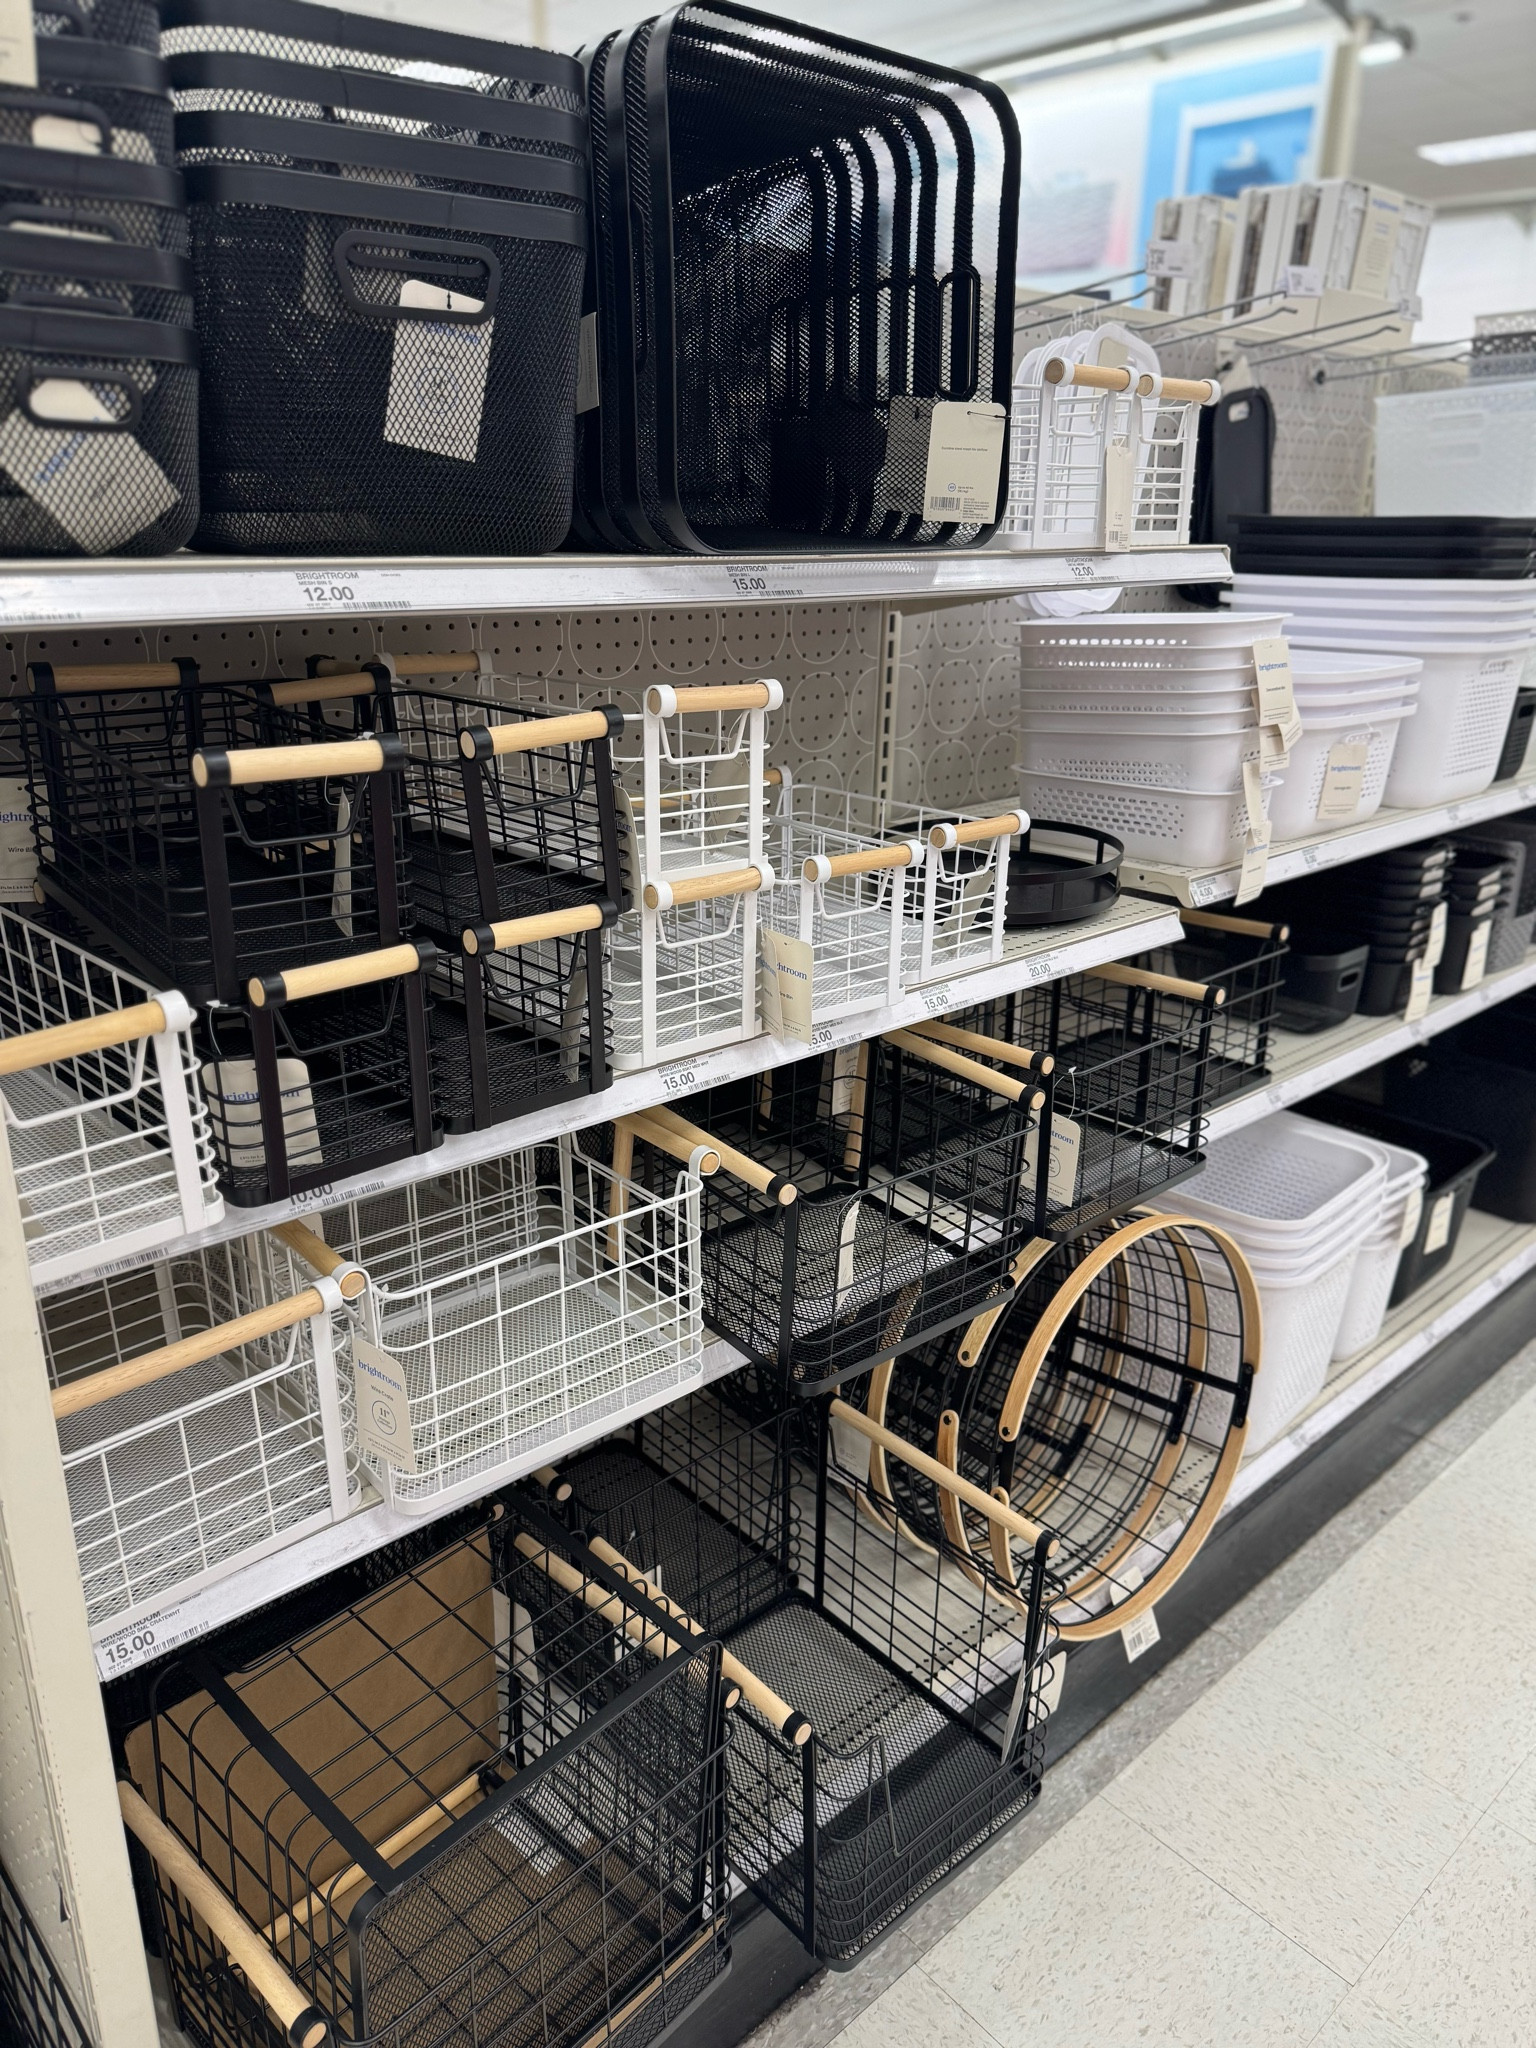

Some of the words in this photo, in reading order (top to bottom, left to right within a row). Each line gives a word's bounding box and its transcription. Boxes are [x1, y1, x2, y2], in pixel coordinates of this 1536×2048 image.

[295, 572, 359, 580] BRIGHTROOM
[1072, 567, 1094, 576] 12.00
[733, 578, 766, 590] 15.00
[303, 586, 354, 601] 12.00
[1259, 662, 1288, 672] brightroom
[1029, 963, 1050, 977] 20.00
[924, 995, 948, 1009] 15.00
[658, 1058, 698, 1074] BRIGHTROOM
[663, 1071, 695, 1090] 15.00
[358, 1359, 402, 1391] brightroom
[101, 1630, 136, 1649] WIRE/WOOD
[106, 1630, 155, 1663] 15.00
